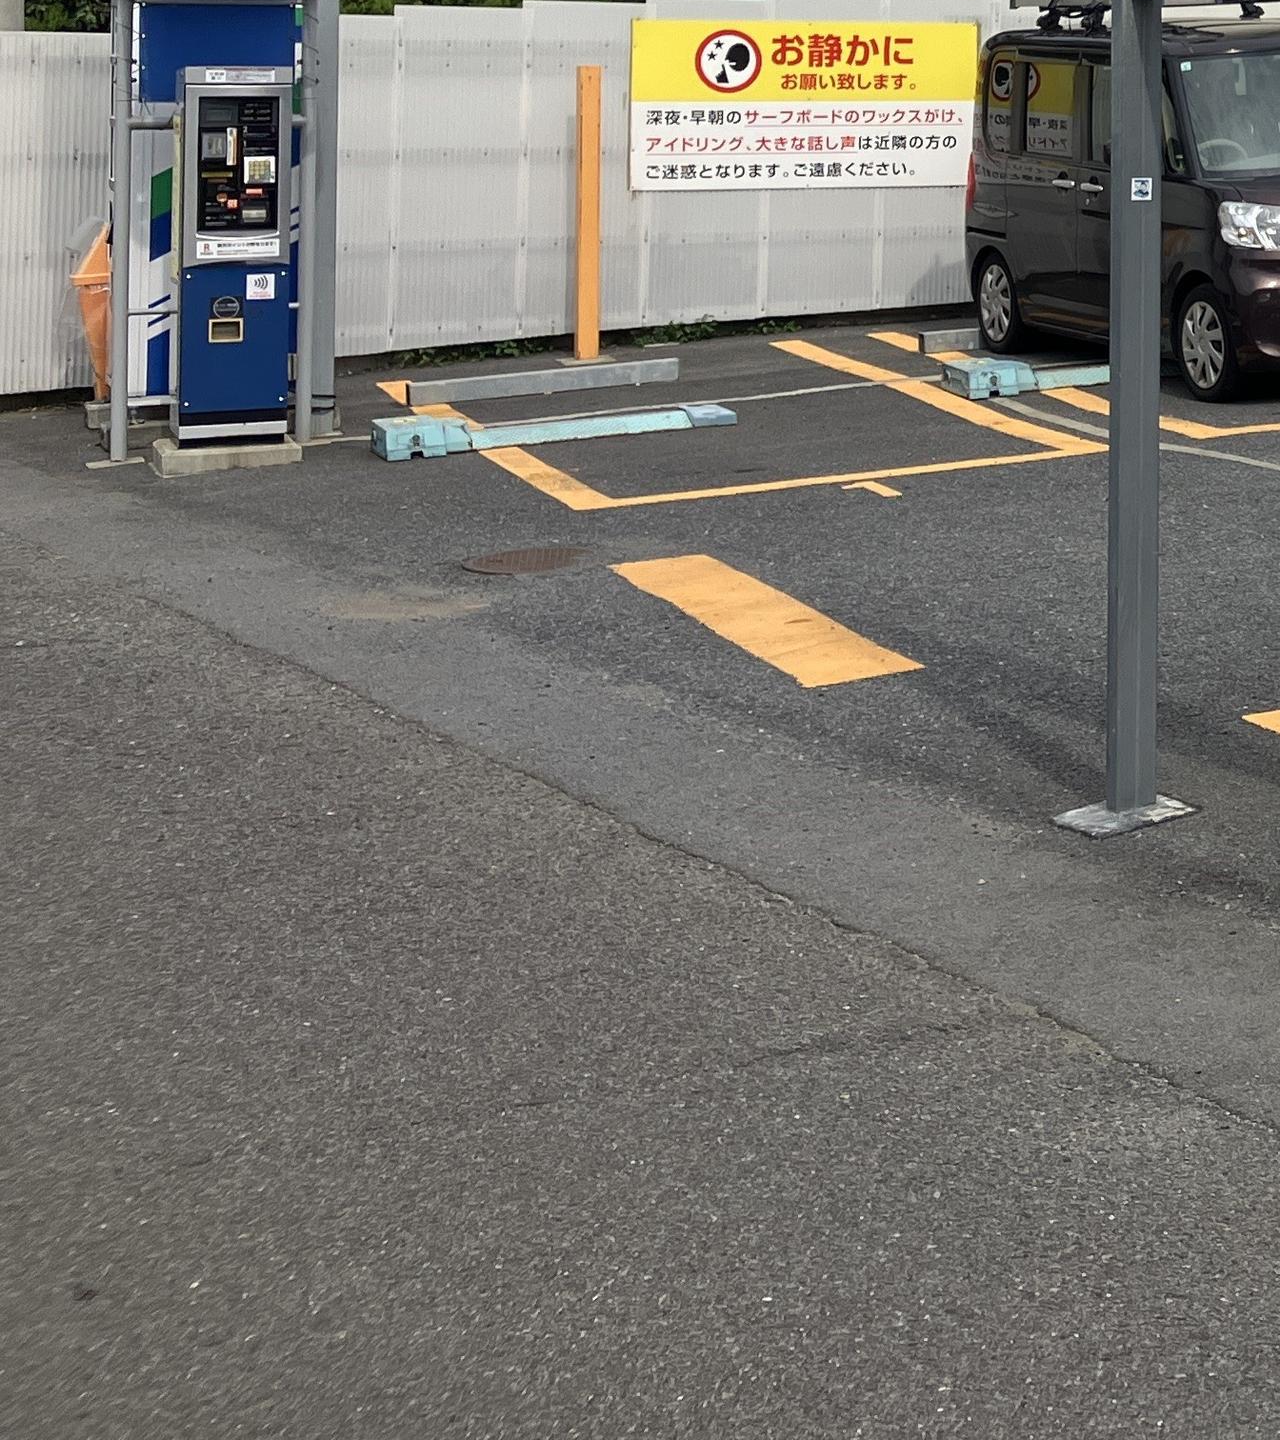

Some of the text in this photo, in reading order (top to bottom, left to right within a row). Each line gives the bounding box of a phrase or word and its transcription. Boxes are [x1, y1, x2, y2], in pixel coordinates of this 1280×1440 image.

[771, 33, 915, 68] お静かに
[780, 73, 918, 92] お願い致します。
[645, 108, 964, 127] 深夜・早朝のサーフボードのワックスがけ、
[645, 134, 957, 153] アイドリング、大きな話し声は近隣の方の
[645, 161, 916, 180] ご迷惑となります。ご遠慮ください。
